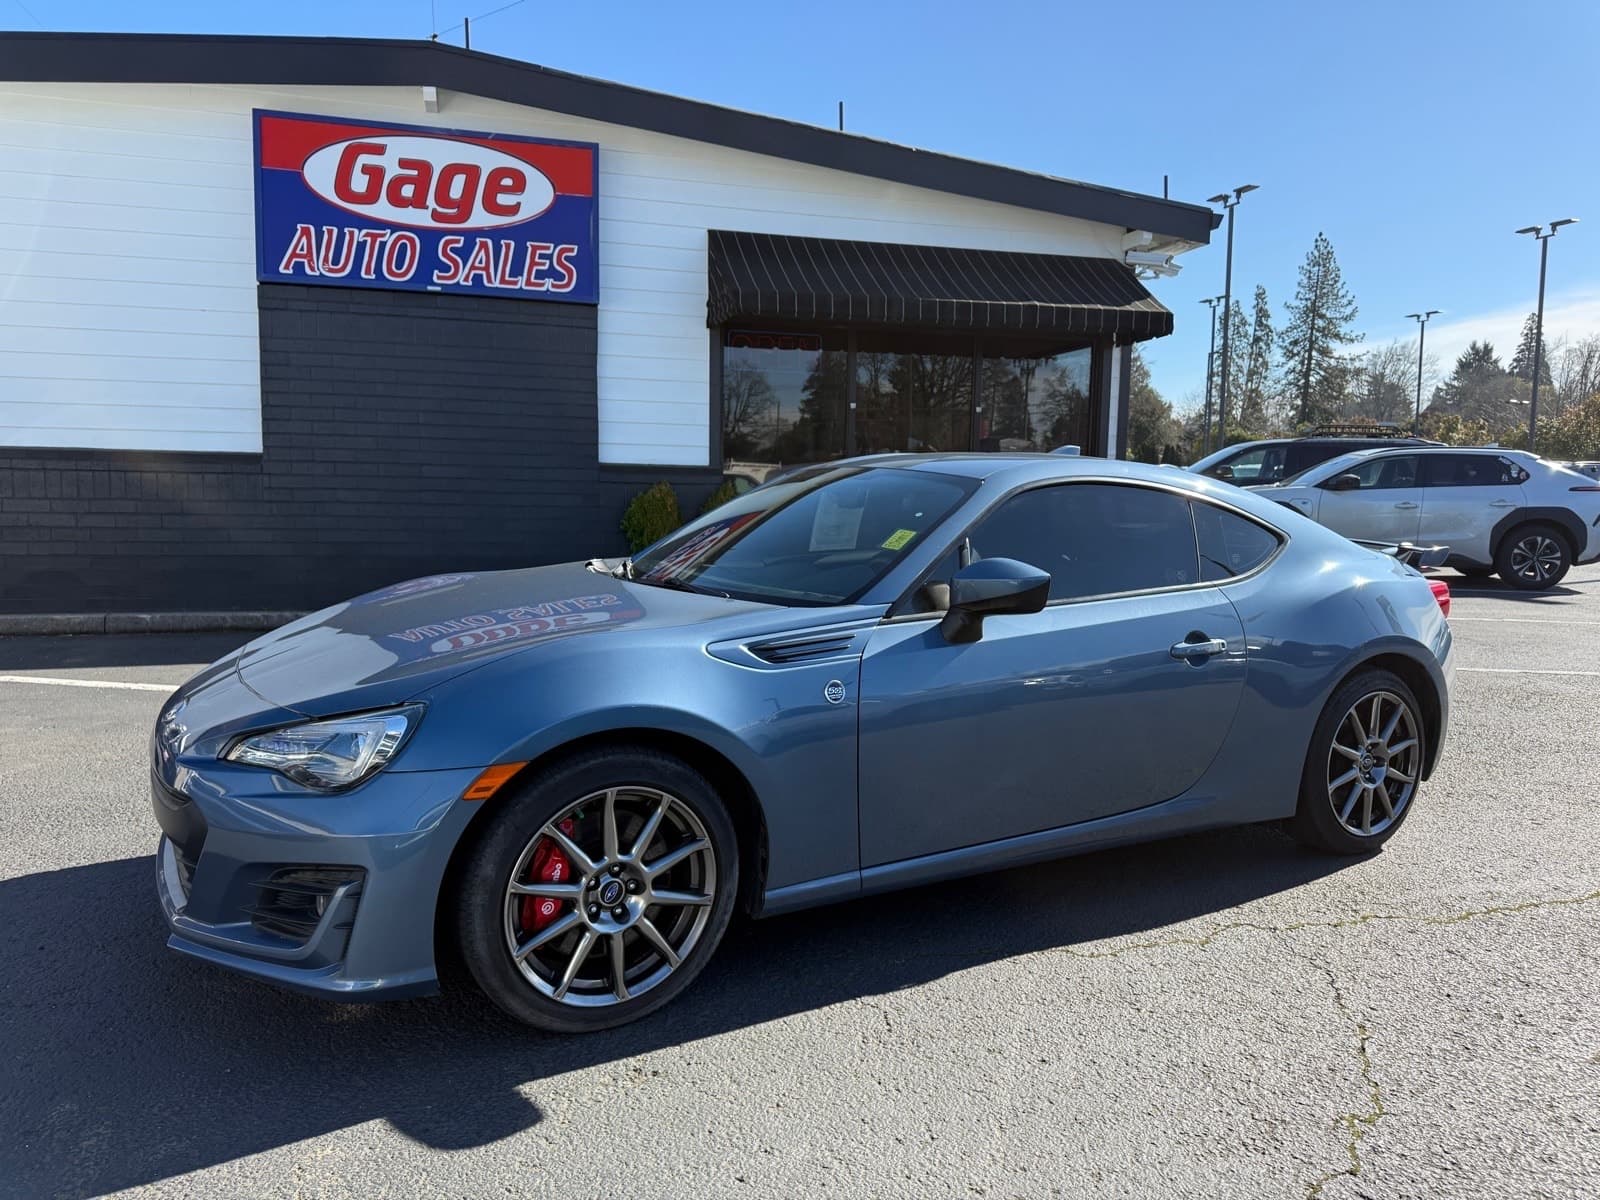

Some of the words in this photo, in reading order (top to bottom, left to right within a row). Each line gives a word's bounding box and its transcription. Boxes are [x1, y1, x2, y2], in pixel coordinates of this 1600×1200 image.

[334, 142, 527, 224] Gage
[279, 224, 420, 281] AUTO
[433, 235, 578, 293] SALES
